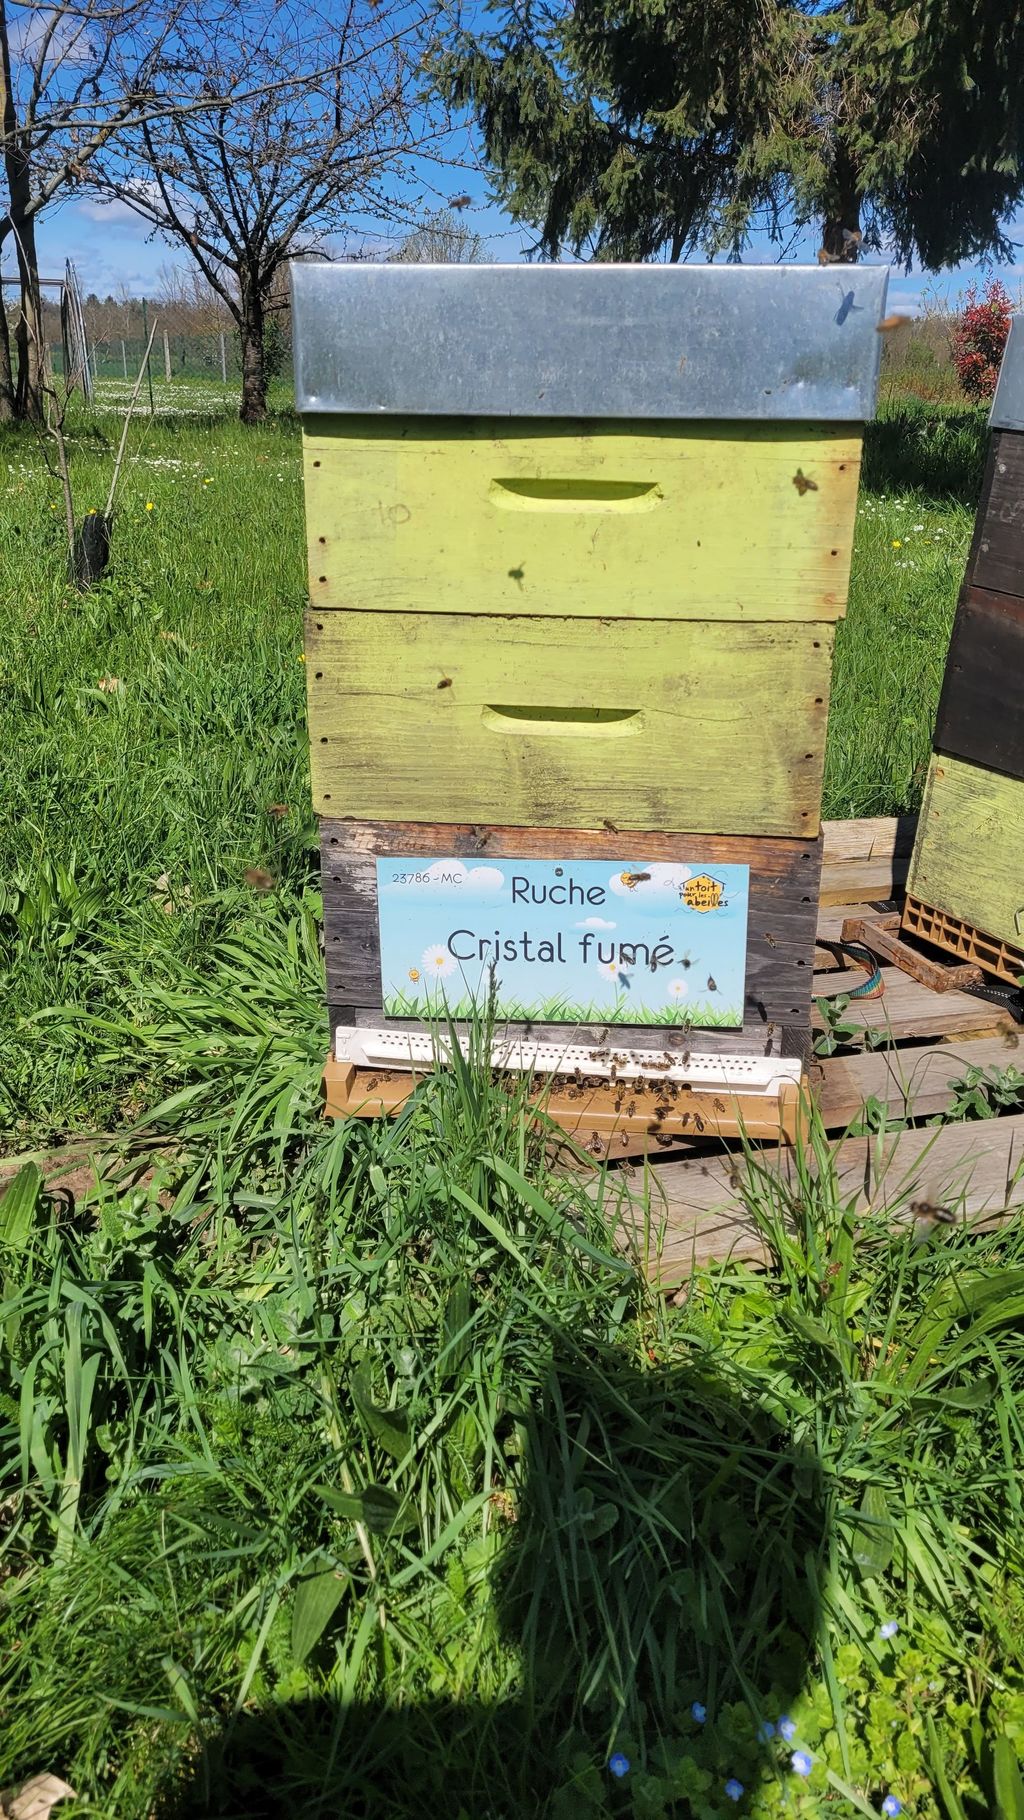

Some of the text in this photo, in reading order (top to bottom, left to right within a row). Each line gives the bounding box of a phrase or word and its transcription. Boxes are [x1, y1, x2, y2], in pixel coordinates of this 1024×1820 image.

[511, 876, 606, 906] Ruche
[695, 881, 717, 892] toit
[687, 893, 729, 907] abeilles
[447, 930, 674, 965] Cristal fumé
